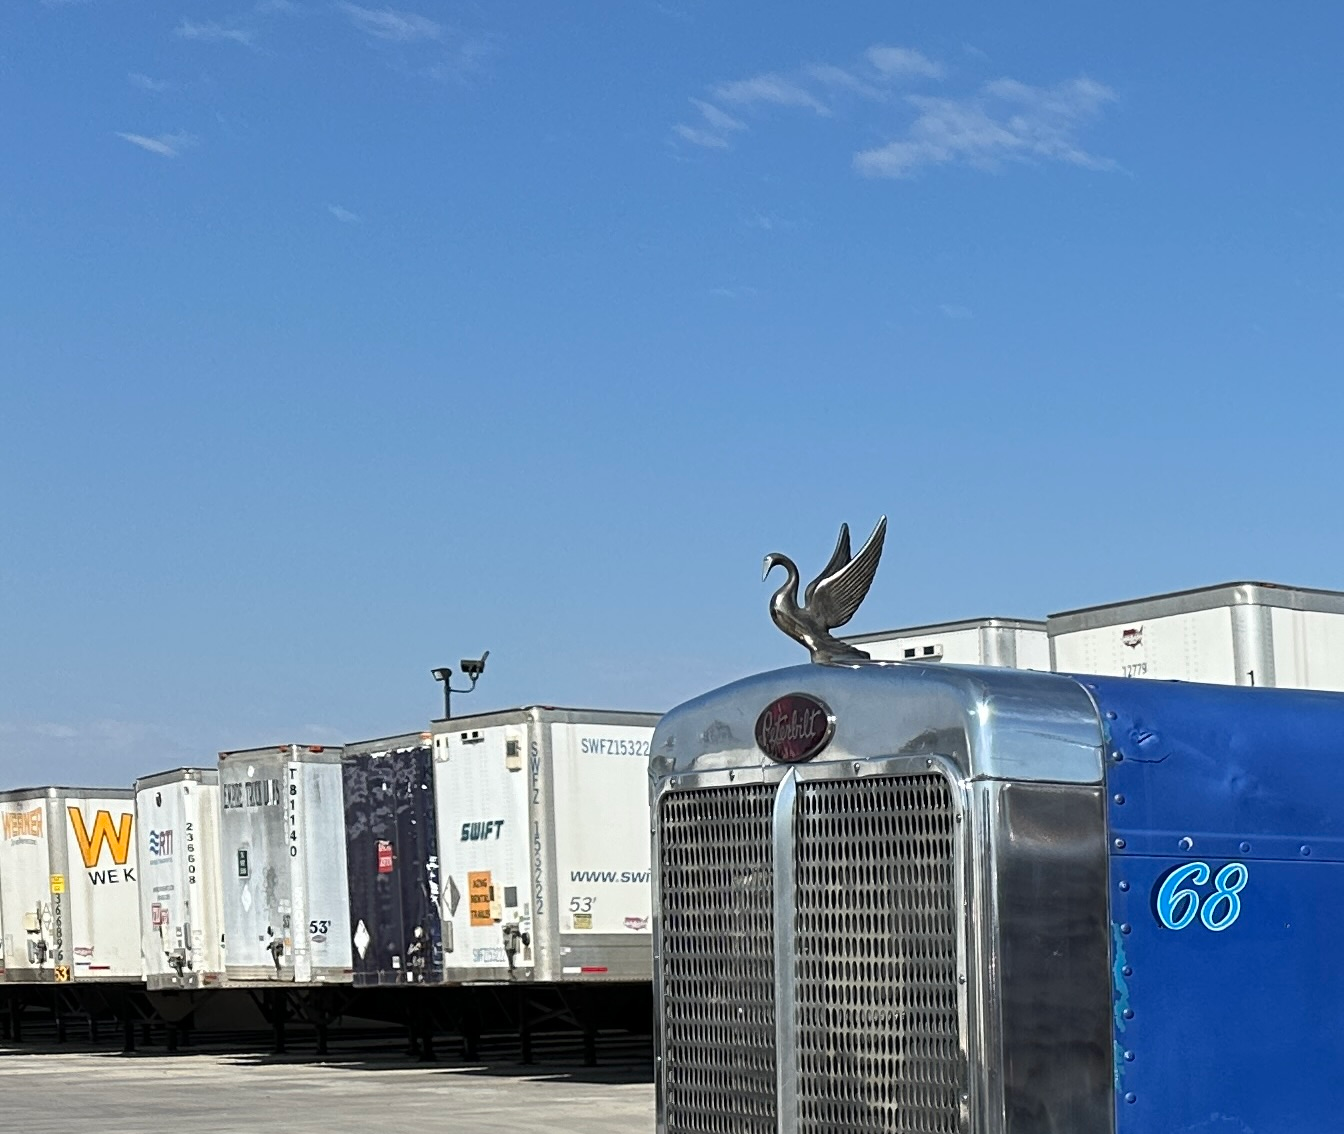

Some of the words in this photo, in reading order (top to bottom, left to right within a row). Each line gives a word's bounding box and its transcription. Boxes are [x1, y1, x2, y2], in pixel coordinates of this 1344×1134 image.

[760, 704, 821, 746] Peterbilt
[288, 768, 298, 857] T81140
[67, 806, 133, 868] W
[460, 819, 505, 842] SWIFT
[88, 869, 120, 885] WE
[123, 868, 137, 882] K
[569, 896, 597, 912] 53'
[1156, 861, 1248, 932] 68
[309, 920, 331, 934] 53'
